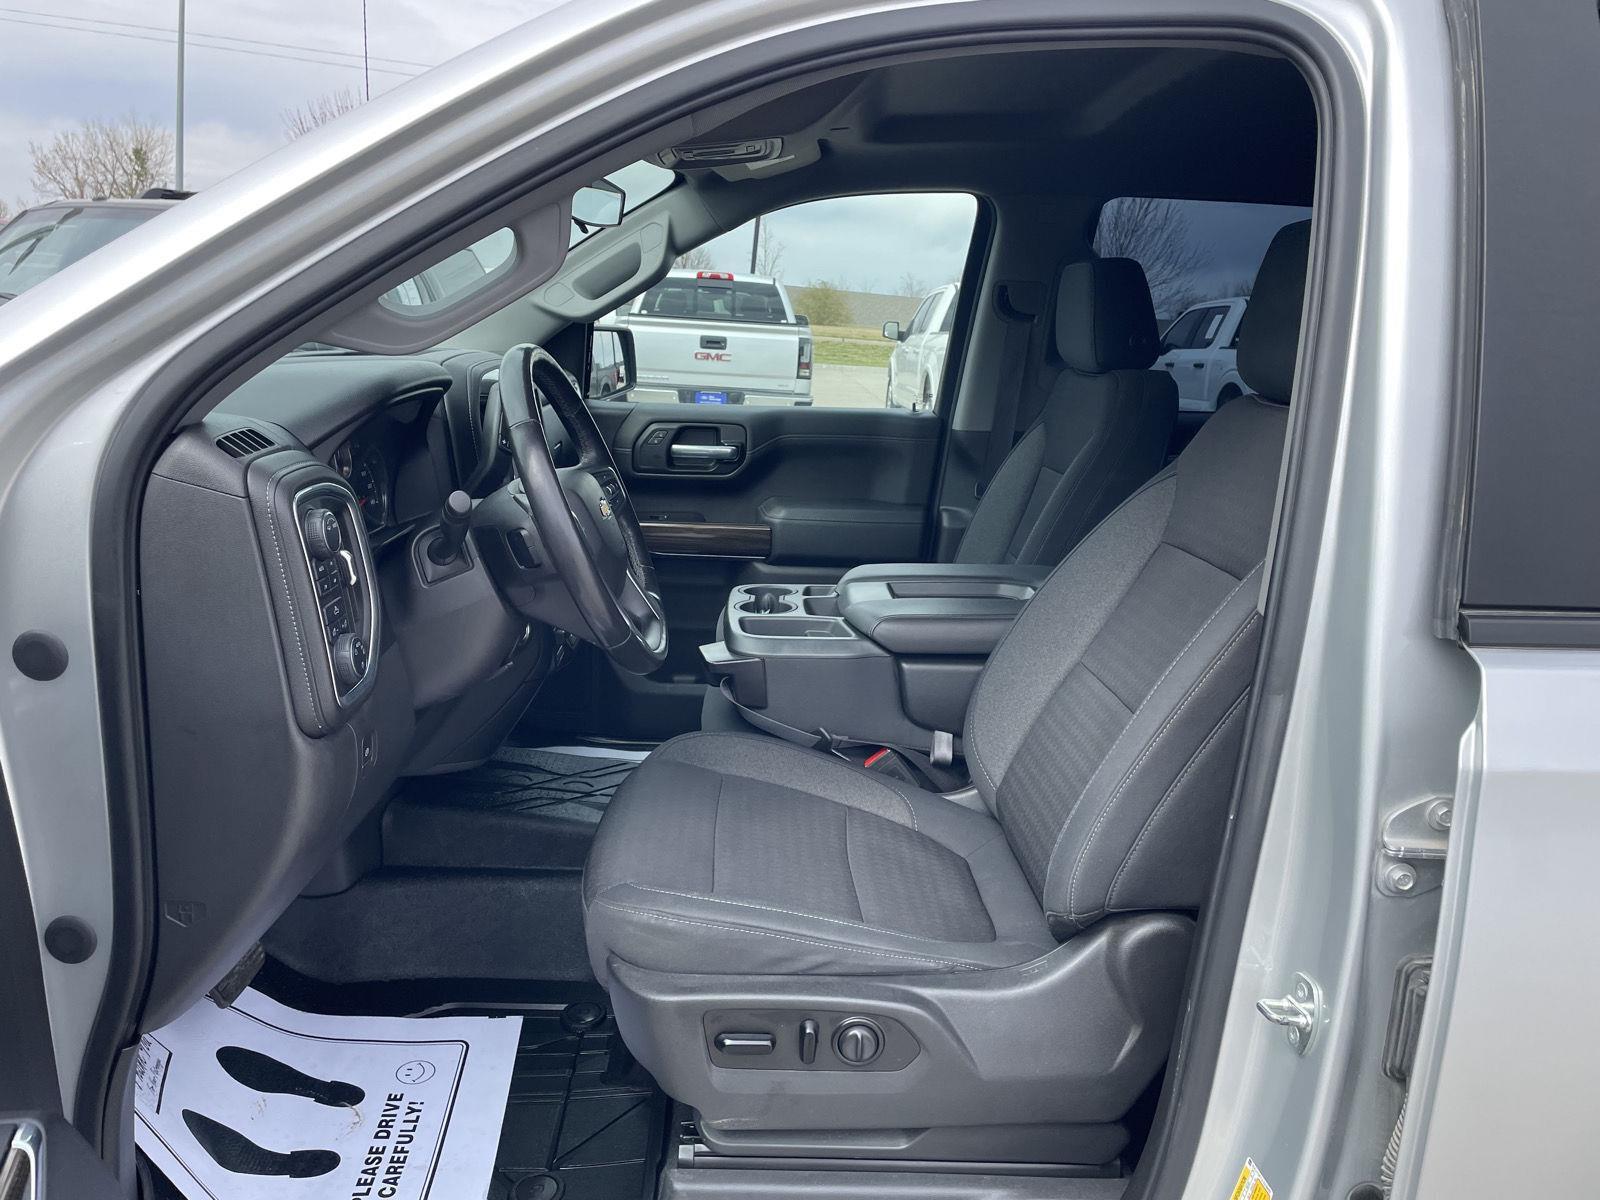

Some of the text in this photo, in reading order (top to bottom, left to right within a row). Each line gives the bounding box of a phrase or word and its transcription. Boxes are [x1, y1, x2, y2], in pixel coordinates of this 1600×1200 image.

[694, 351, 732, 362] GMC
[352, 1093, 404, 1200] LEASE DRIVE
[377, 1101, 424, 1198] CAREFULLY!
